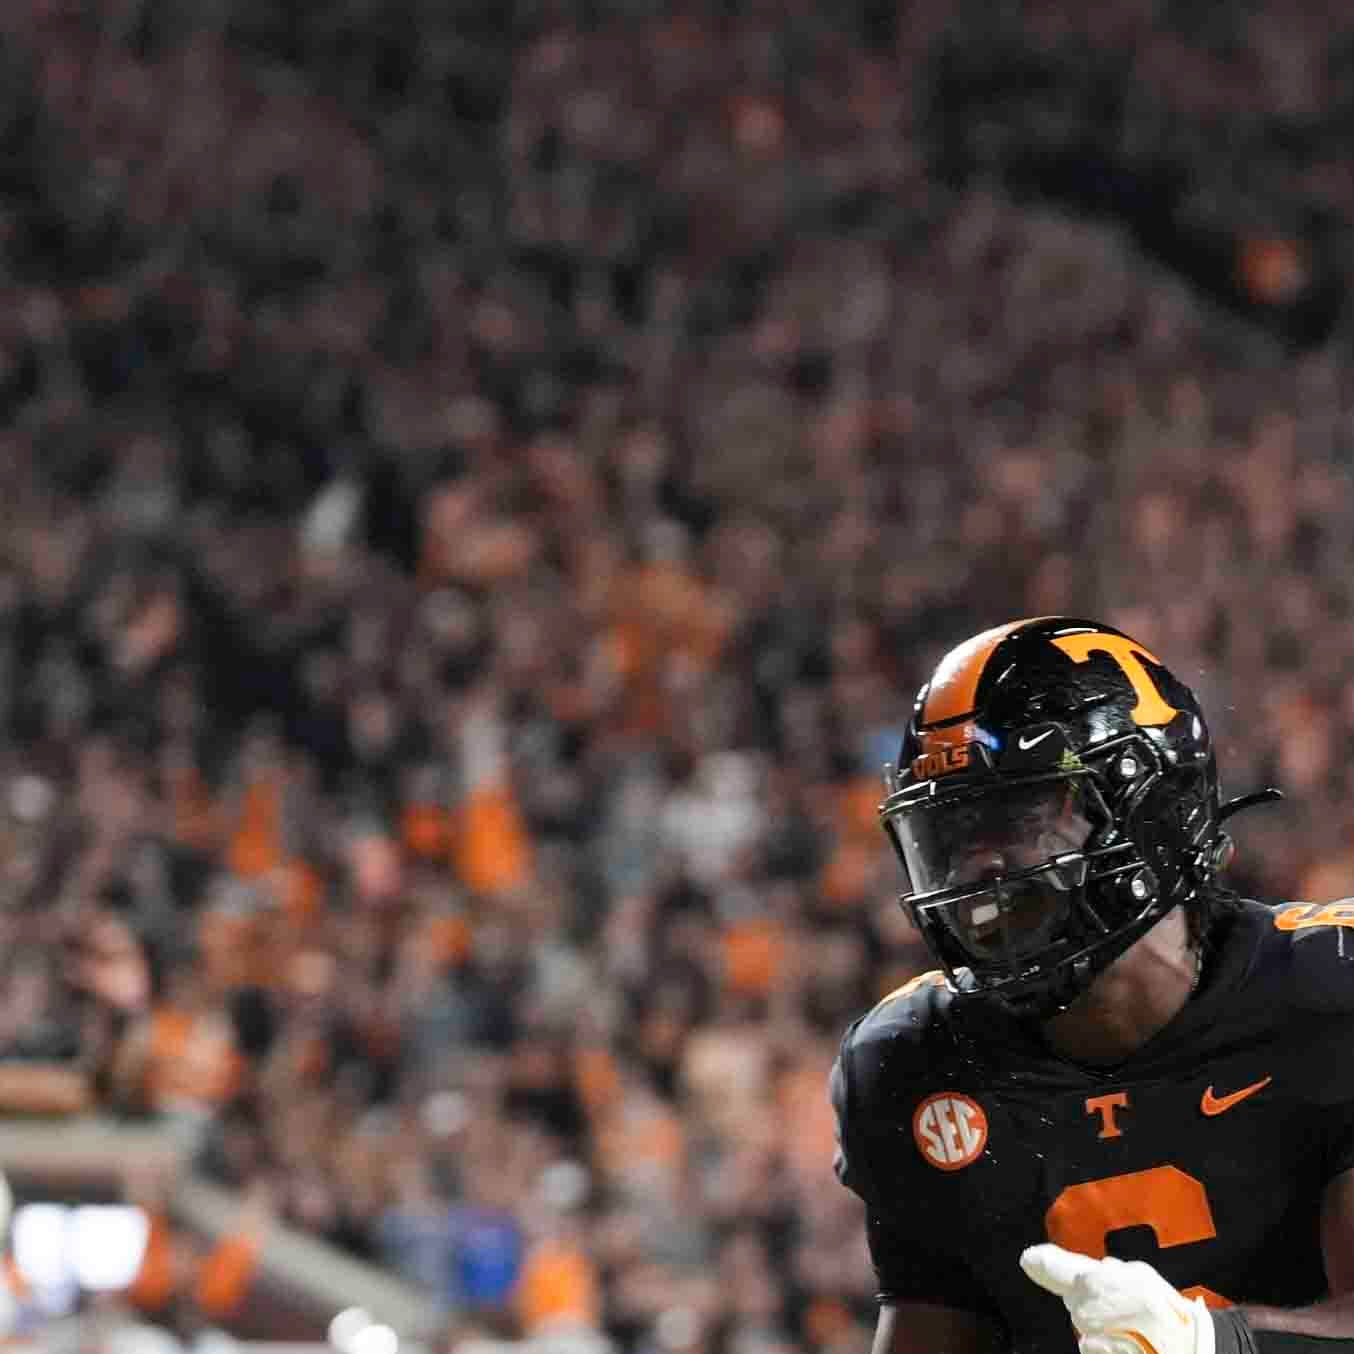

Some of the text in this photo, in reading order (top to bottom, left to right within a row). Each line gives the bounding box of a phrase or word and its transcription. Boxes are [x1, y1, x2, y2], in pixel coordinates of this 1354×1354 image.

[1050, 632, 1183, 727] T
[919, 1098, 983, 1163] SEC
[1085, 1092, 1128, 1139] T
